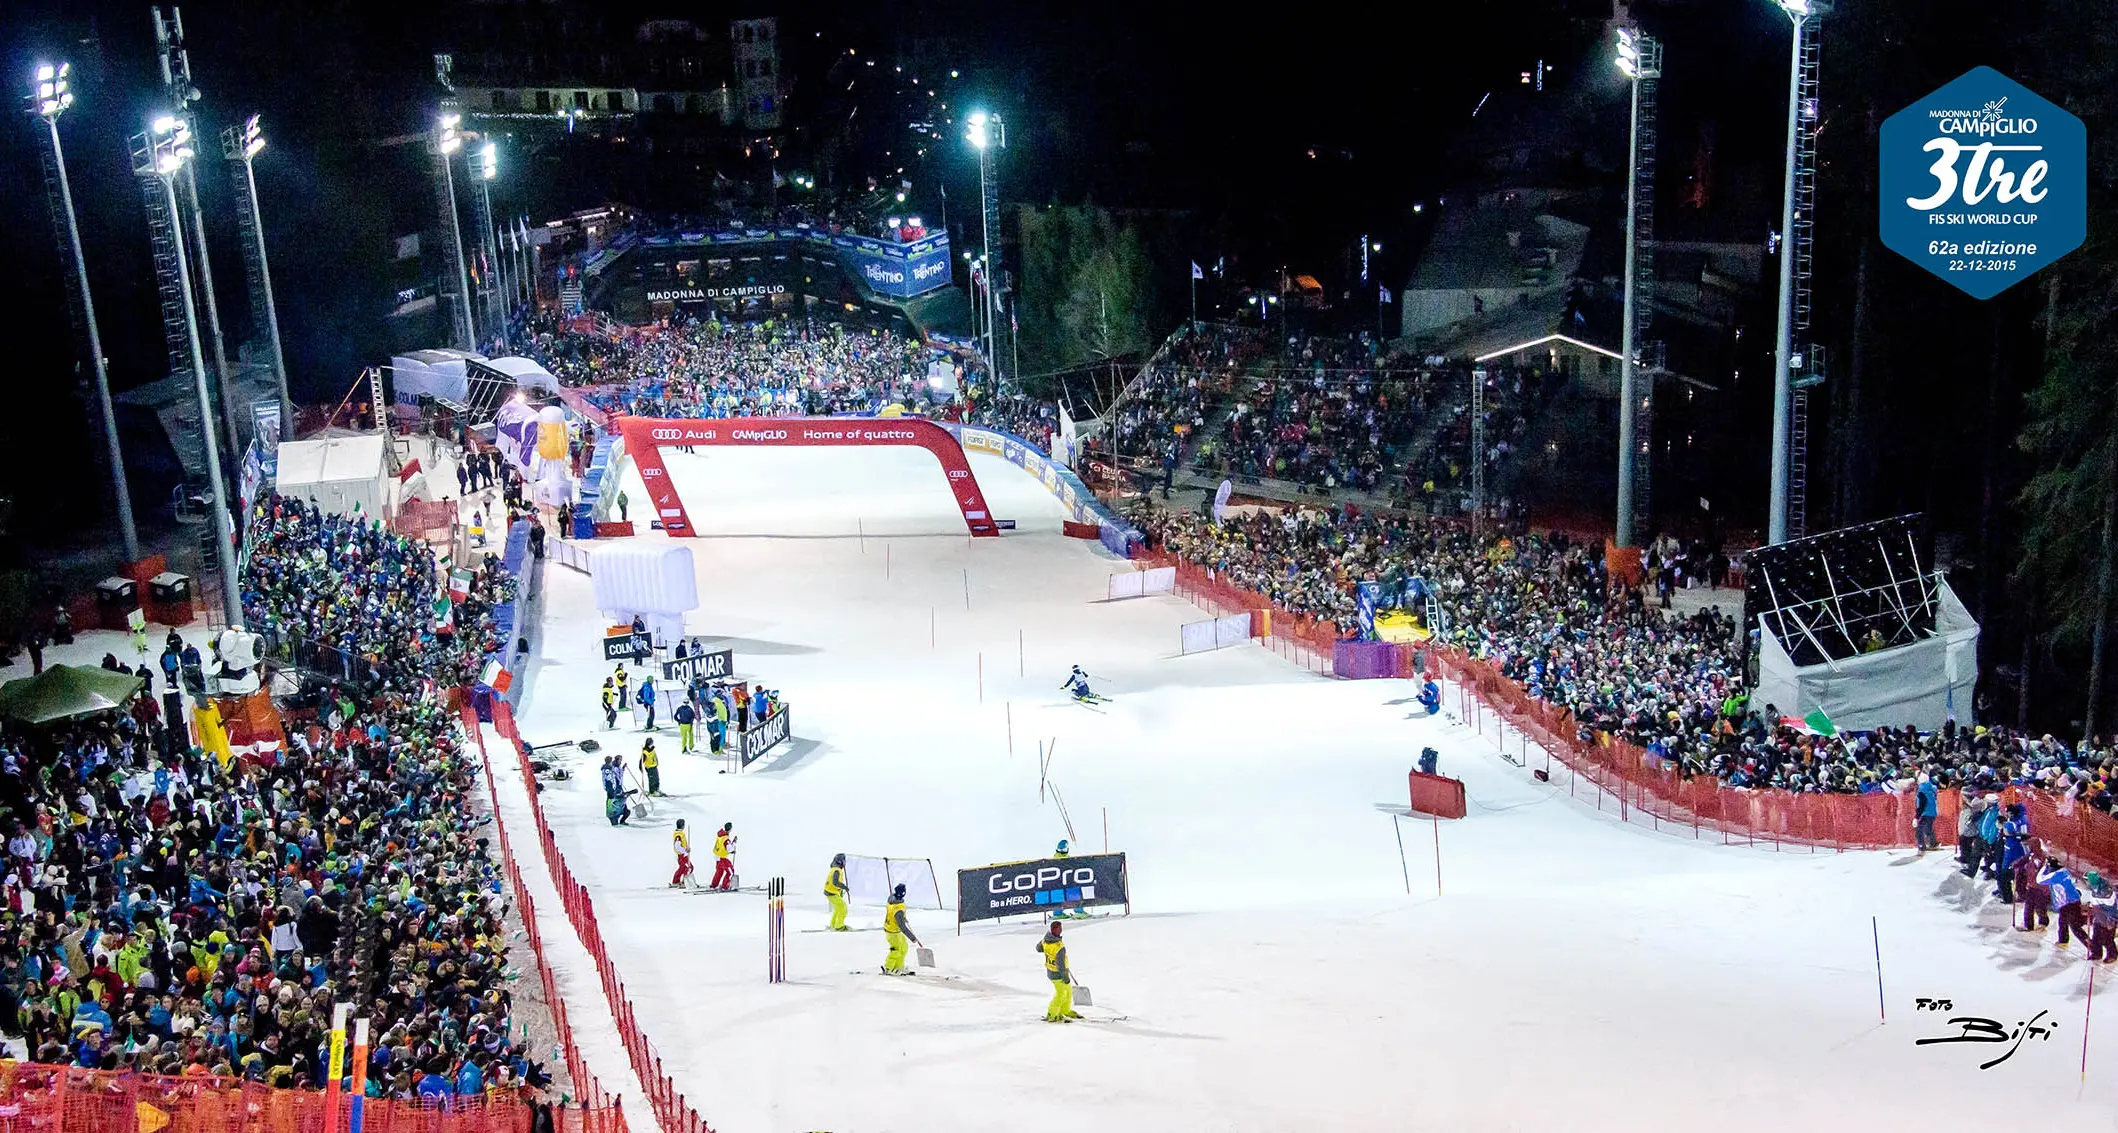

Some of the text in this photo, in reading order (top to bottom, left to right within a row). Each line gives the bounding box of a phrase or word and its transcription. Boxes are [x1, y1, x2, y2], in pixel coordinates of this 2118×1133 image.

[647, 284, 785, 300] MADONNA DI CAMPIGLIO
[685, 430, 717, 439] Audi
[803, 430, 915, 441] Home of quattro
[609, 640, 648, 656] COLMR
[671, 654, 725, 681] COLMAR
[746, 712, 785, 759] COLMAR
[990, 899, 1000, 908] Be
[1005, 895, 1033, 906] HERO.
